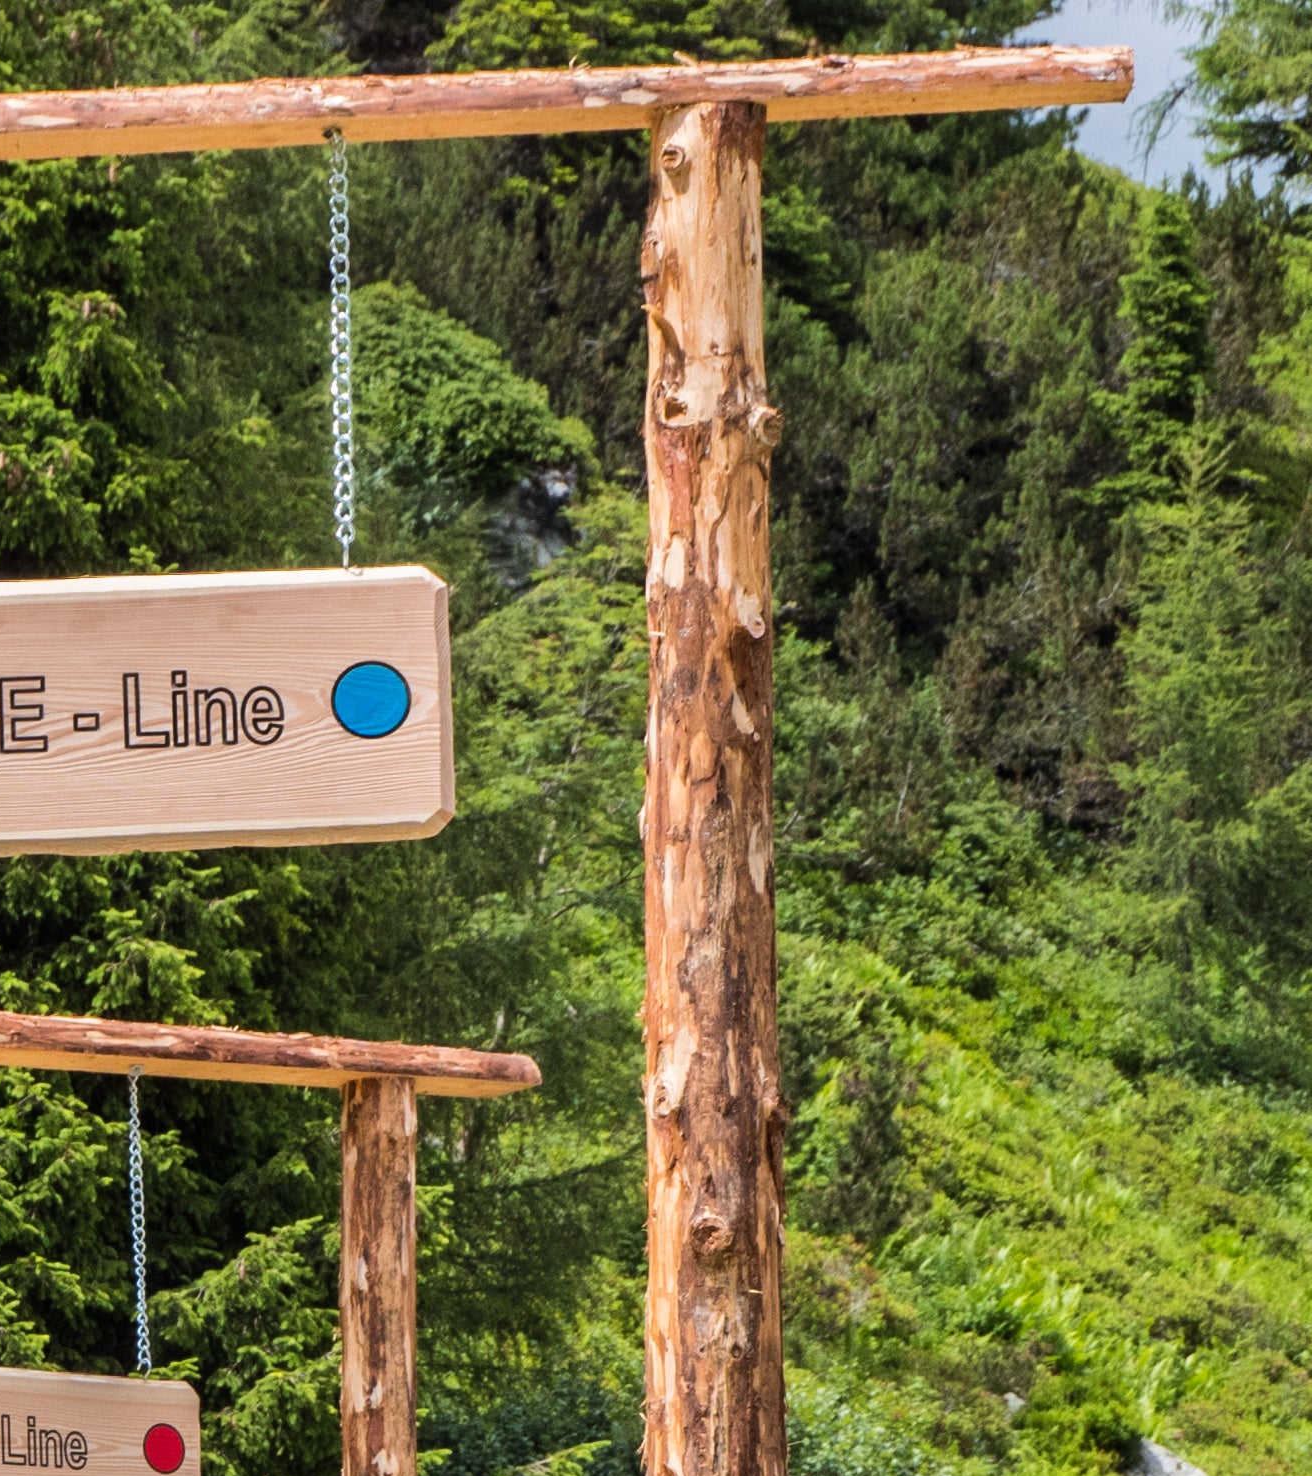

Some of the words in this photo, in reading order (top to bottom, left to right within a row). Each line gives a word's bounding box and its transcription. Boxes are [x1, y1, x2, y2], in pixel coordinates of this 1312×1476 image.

[72, 712, 100, 732] -
[122, 670, 285, 751] Line
[0, 1414, 88, 1471] Line
